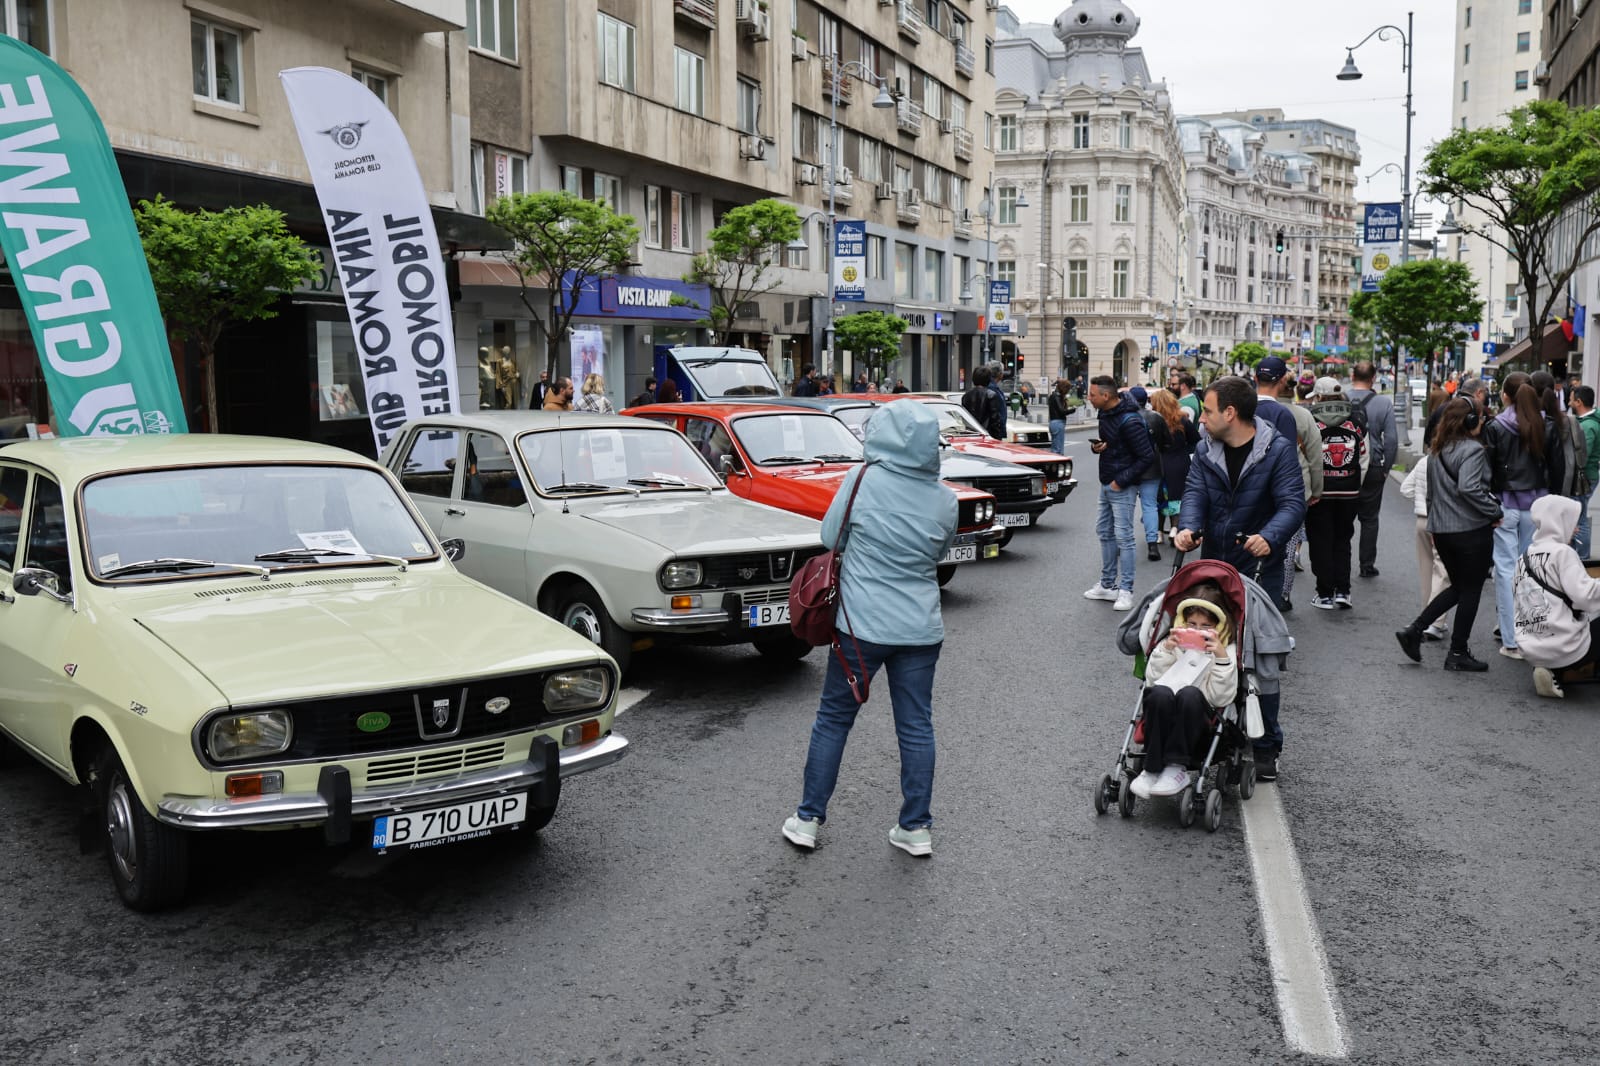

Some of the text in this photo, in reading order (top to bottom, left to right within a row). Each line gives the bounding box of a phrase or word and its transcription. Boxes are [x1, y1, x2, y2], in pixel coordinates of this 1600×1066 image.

[617, 286, 673, 308] VISTA BANK
[955, 547, 973, 560] CFO
[761, 607, 772, 624] B
[363, 717, 384, 726] FIVA
[392, 797, 519, 843] B 710 UAP
[373, 834, 386, 846] RO
[409, 838, 446, 850] FABRICAT
